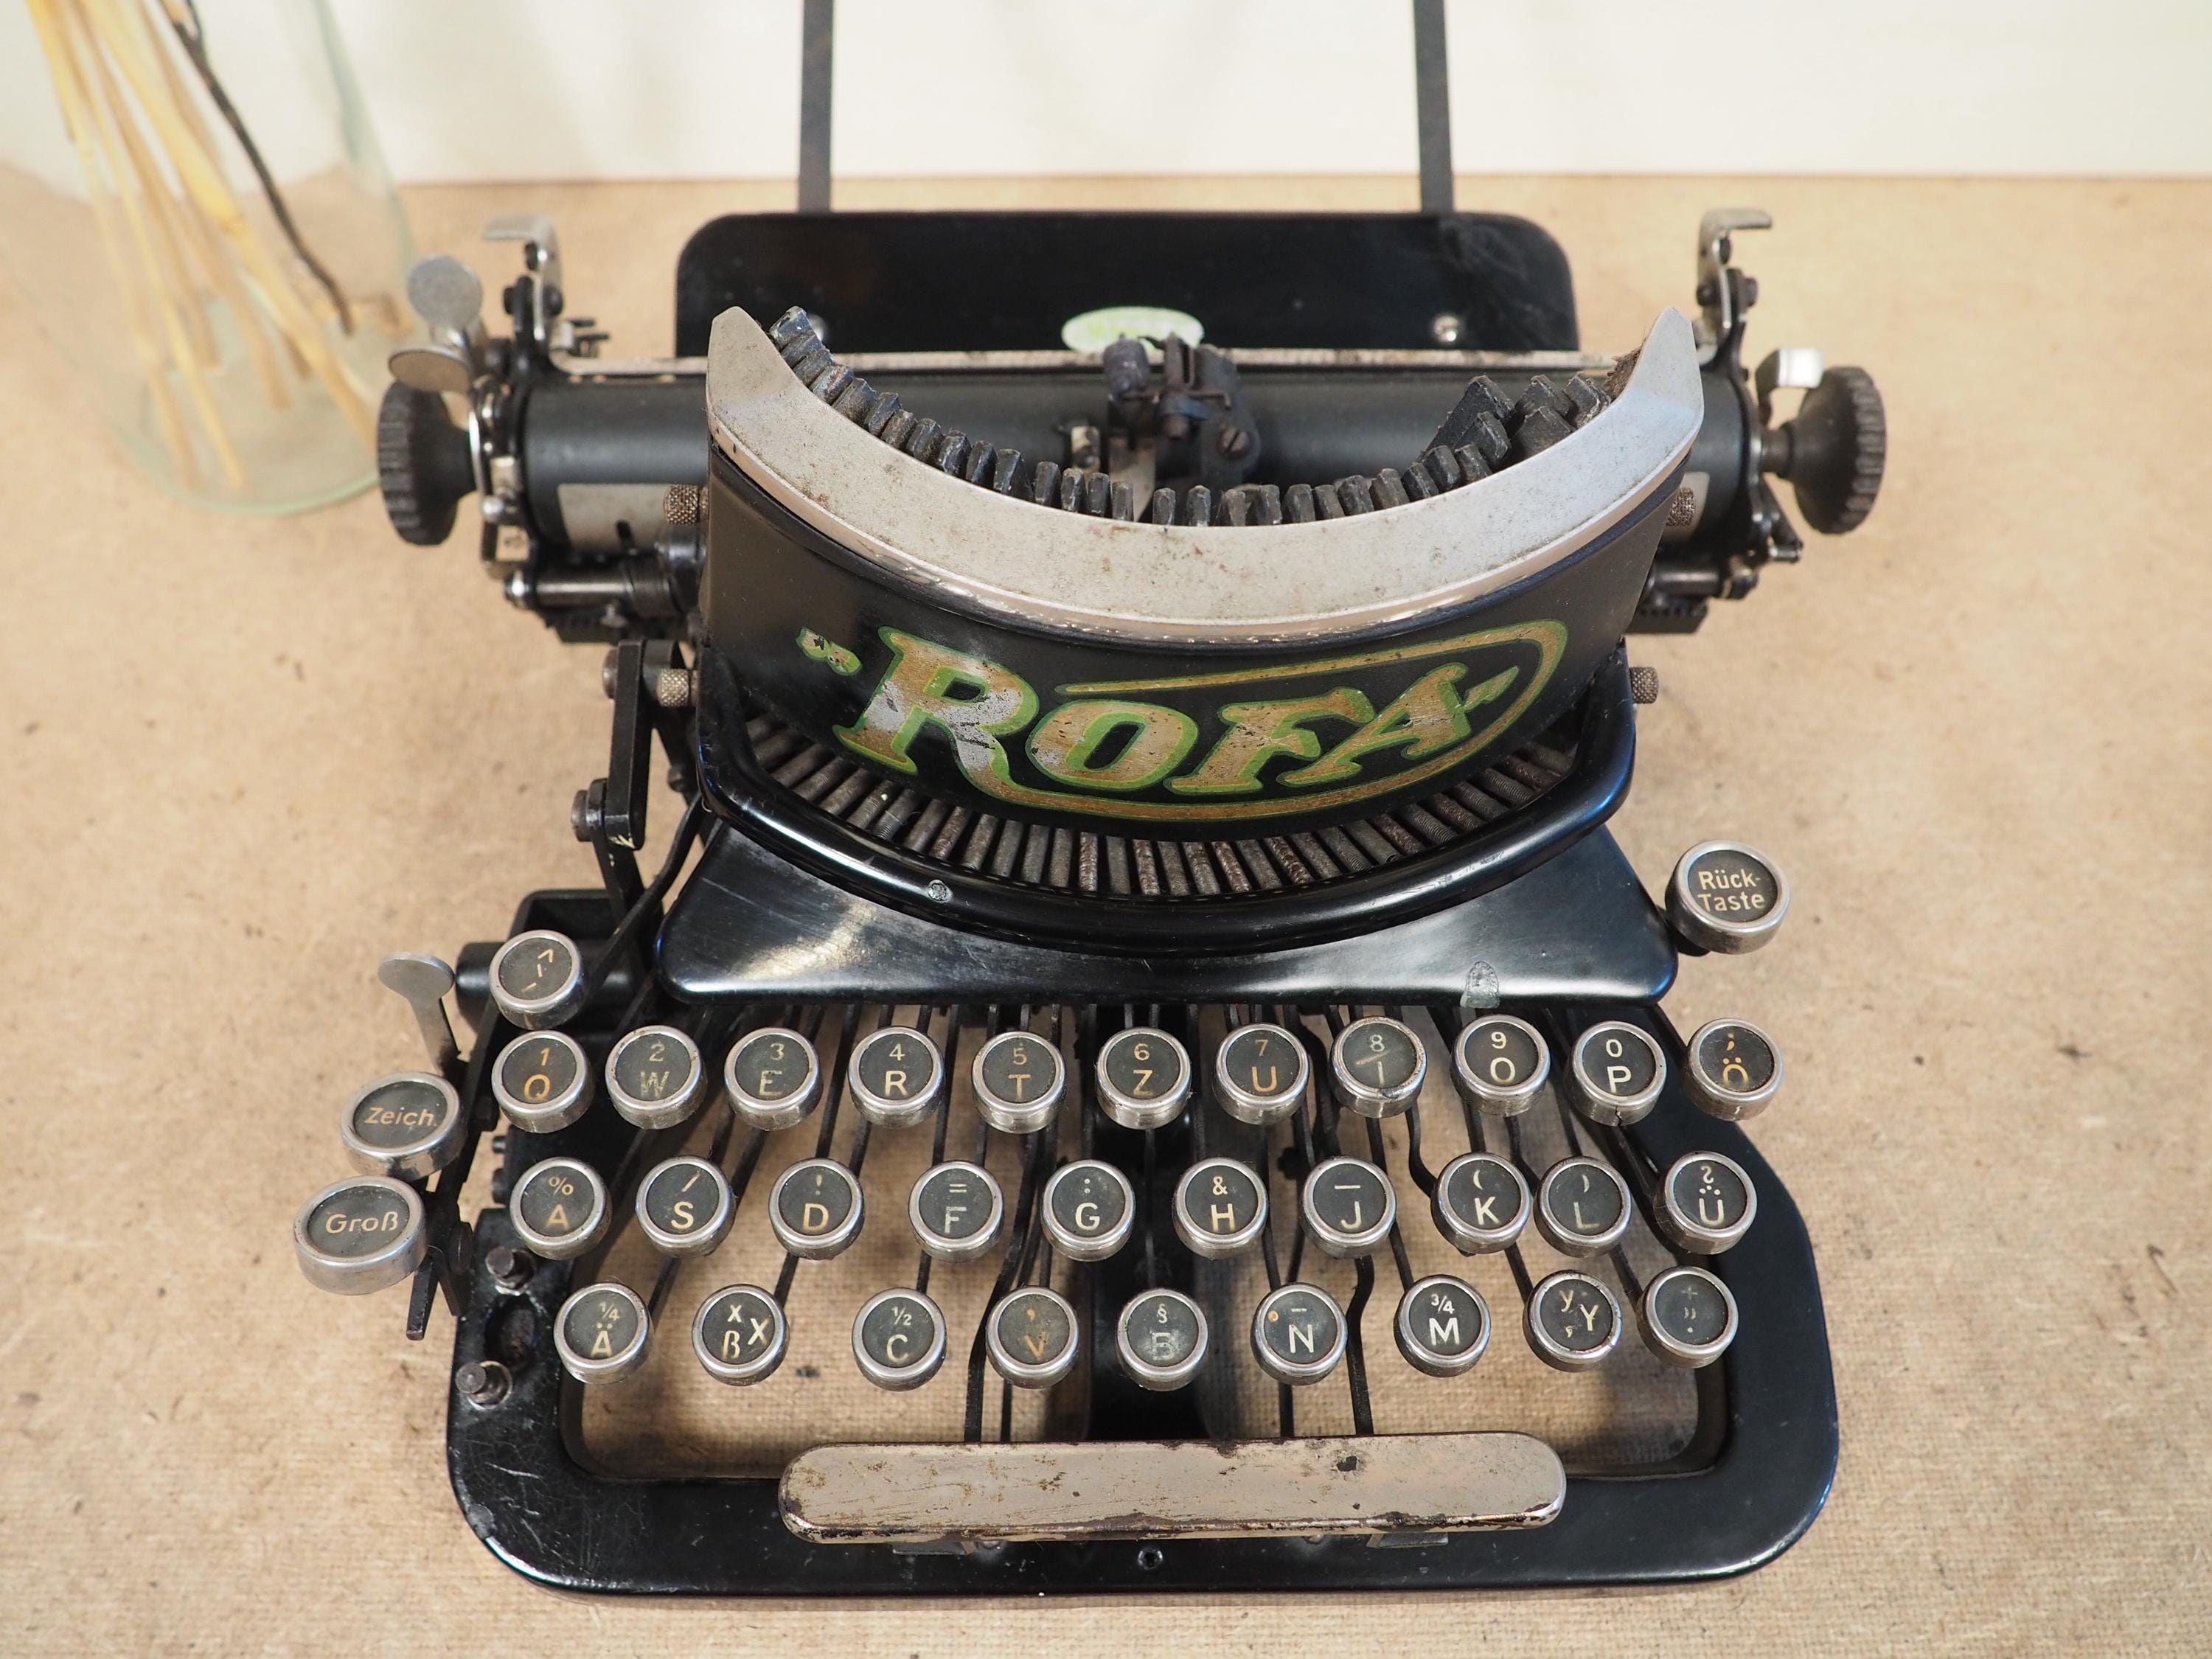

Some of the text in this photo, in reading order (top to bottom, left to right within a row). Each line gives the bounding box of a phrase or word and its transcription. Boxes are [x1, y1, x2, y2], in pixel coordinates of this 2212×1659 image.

[833, 625, 1526, 802] ROFA
[1697, 891, 1764, 912] Taste
[650, 1044, 665, 1061] 2
[770, 1043, 785, 1060] 3
[889, 1043, 905, 1061] 4
[1134, 1043, 1150, 1061] 6
[1255, 1039, 1268, 1056] 7
[1370, 1034, 1385, 1052] 8
[1491, 1032, 1506, 1049] 9
[540, 1048, 550, 1066] 1
[1012, 1047, 1027, 1065] 5
[1133, 1070, 1153, 1096] Z
[1252, 1066, 1277, 1092] U
[1490, 1057, 1515, 1083] O
[1607, 1065, 1632, 1093] P
[524, 1074, 550, 1100] Q
[641, 1071, 669, 1096] W
[759, 1071, 783, 1096] E
[886, 1071, 908, 1096] R
[1009, 1074, 1031, 1101] T
[549, 1177, 574, 1195] %
[1212, 1176, 1228, 1195] &
[326, 1211, 399, 1234] Groß
[546, 1204, 569, 1229] A
[671, 1201, 694, 1230] S
[802, 1203, 830, 1231] D
[945, 1206, 967, 1234] F
[1075, 1203, 1100, 1231] G
[1211, 1203, 1235, 1231] H
[1340, 1201, 1361, 1229] J
[1474, 1197, 1500, 1225] K
[1573, 1202, 1599, 1229] L
[1579, 1304, 1599, 1331] Y
[591, 1323, 612, 1357] Ä
[747, 1318, 769, 1345] X
[1289, 1324, 1314, 1353] N
[1429, 1318, 1460, 1346] M
[887, 1335, 908, 1362] C
